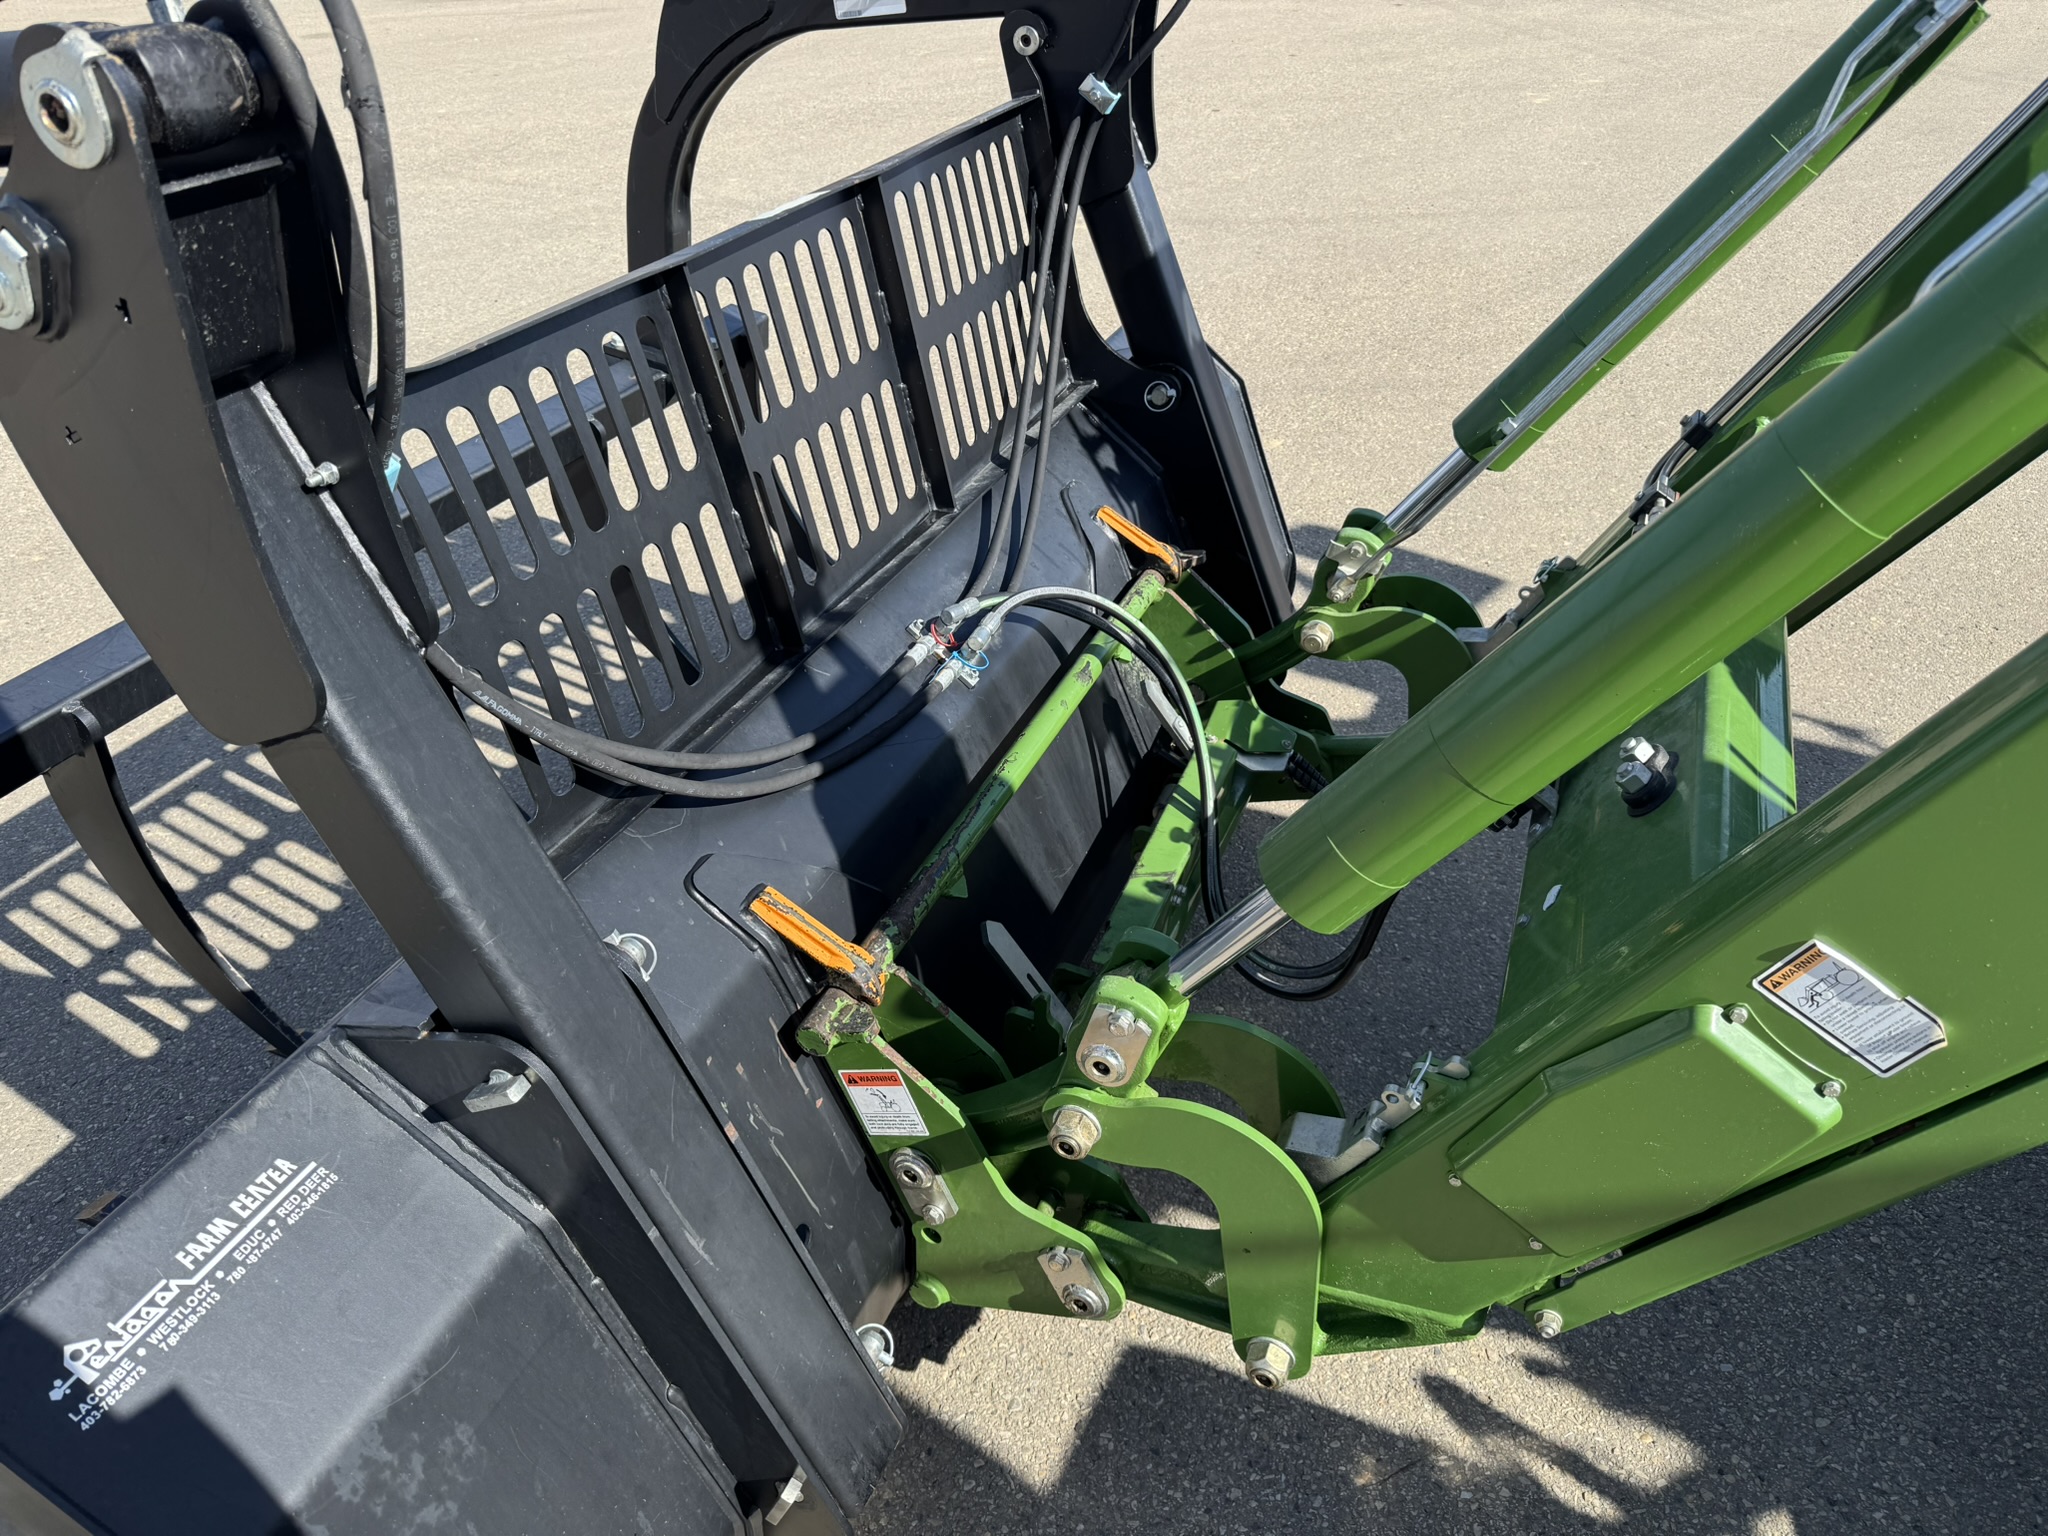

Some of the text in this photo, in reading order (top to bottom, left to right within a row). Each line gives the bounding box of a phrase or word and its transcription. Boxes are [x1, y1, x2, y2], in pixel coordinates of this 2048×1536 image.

[386, 214, 397, 234] 100
[857, 1075, 898, 1083] WARNING
[63, 1158, 298, 1385] Pentagon FARM CENTER
[68, 1357, 135, 1422] LACOMBE
[146, 1280, 215, 1345] WESTLOCK
[276, 1194, 301, 1218] RED
[298, 1167, 329, 1196] DEER
[80, 1365, 147, 1431] 403-782-6873
